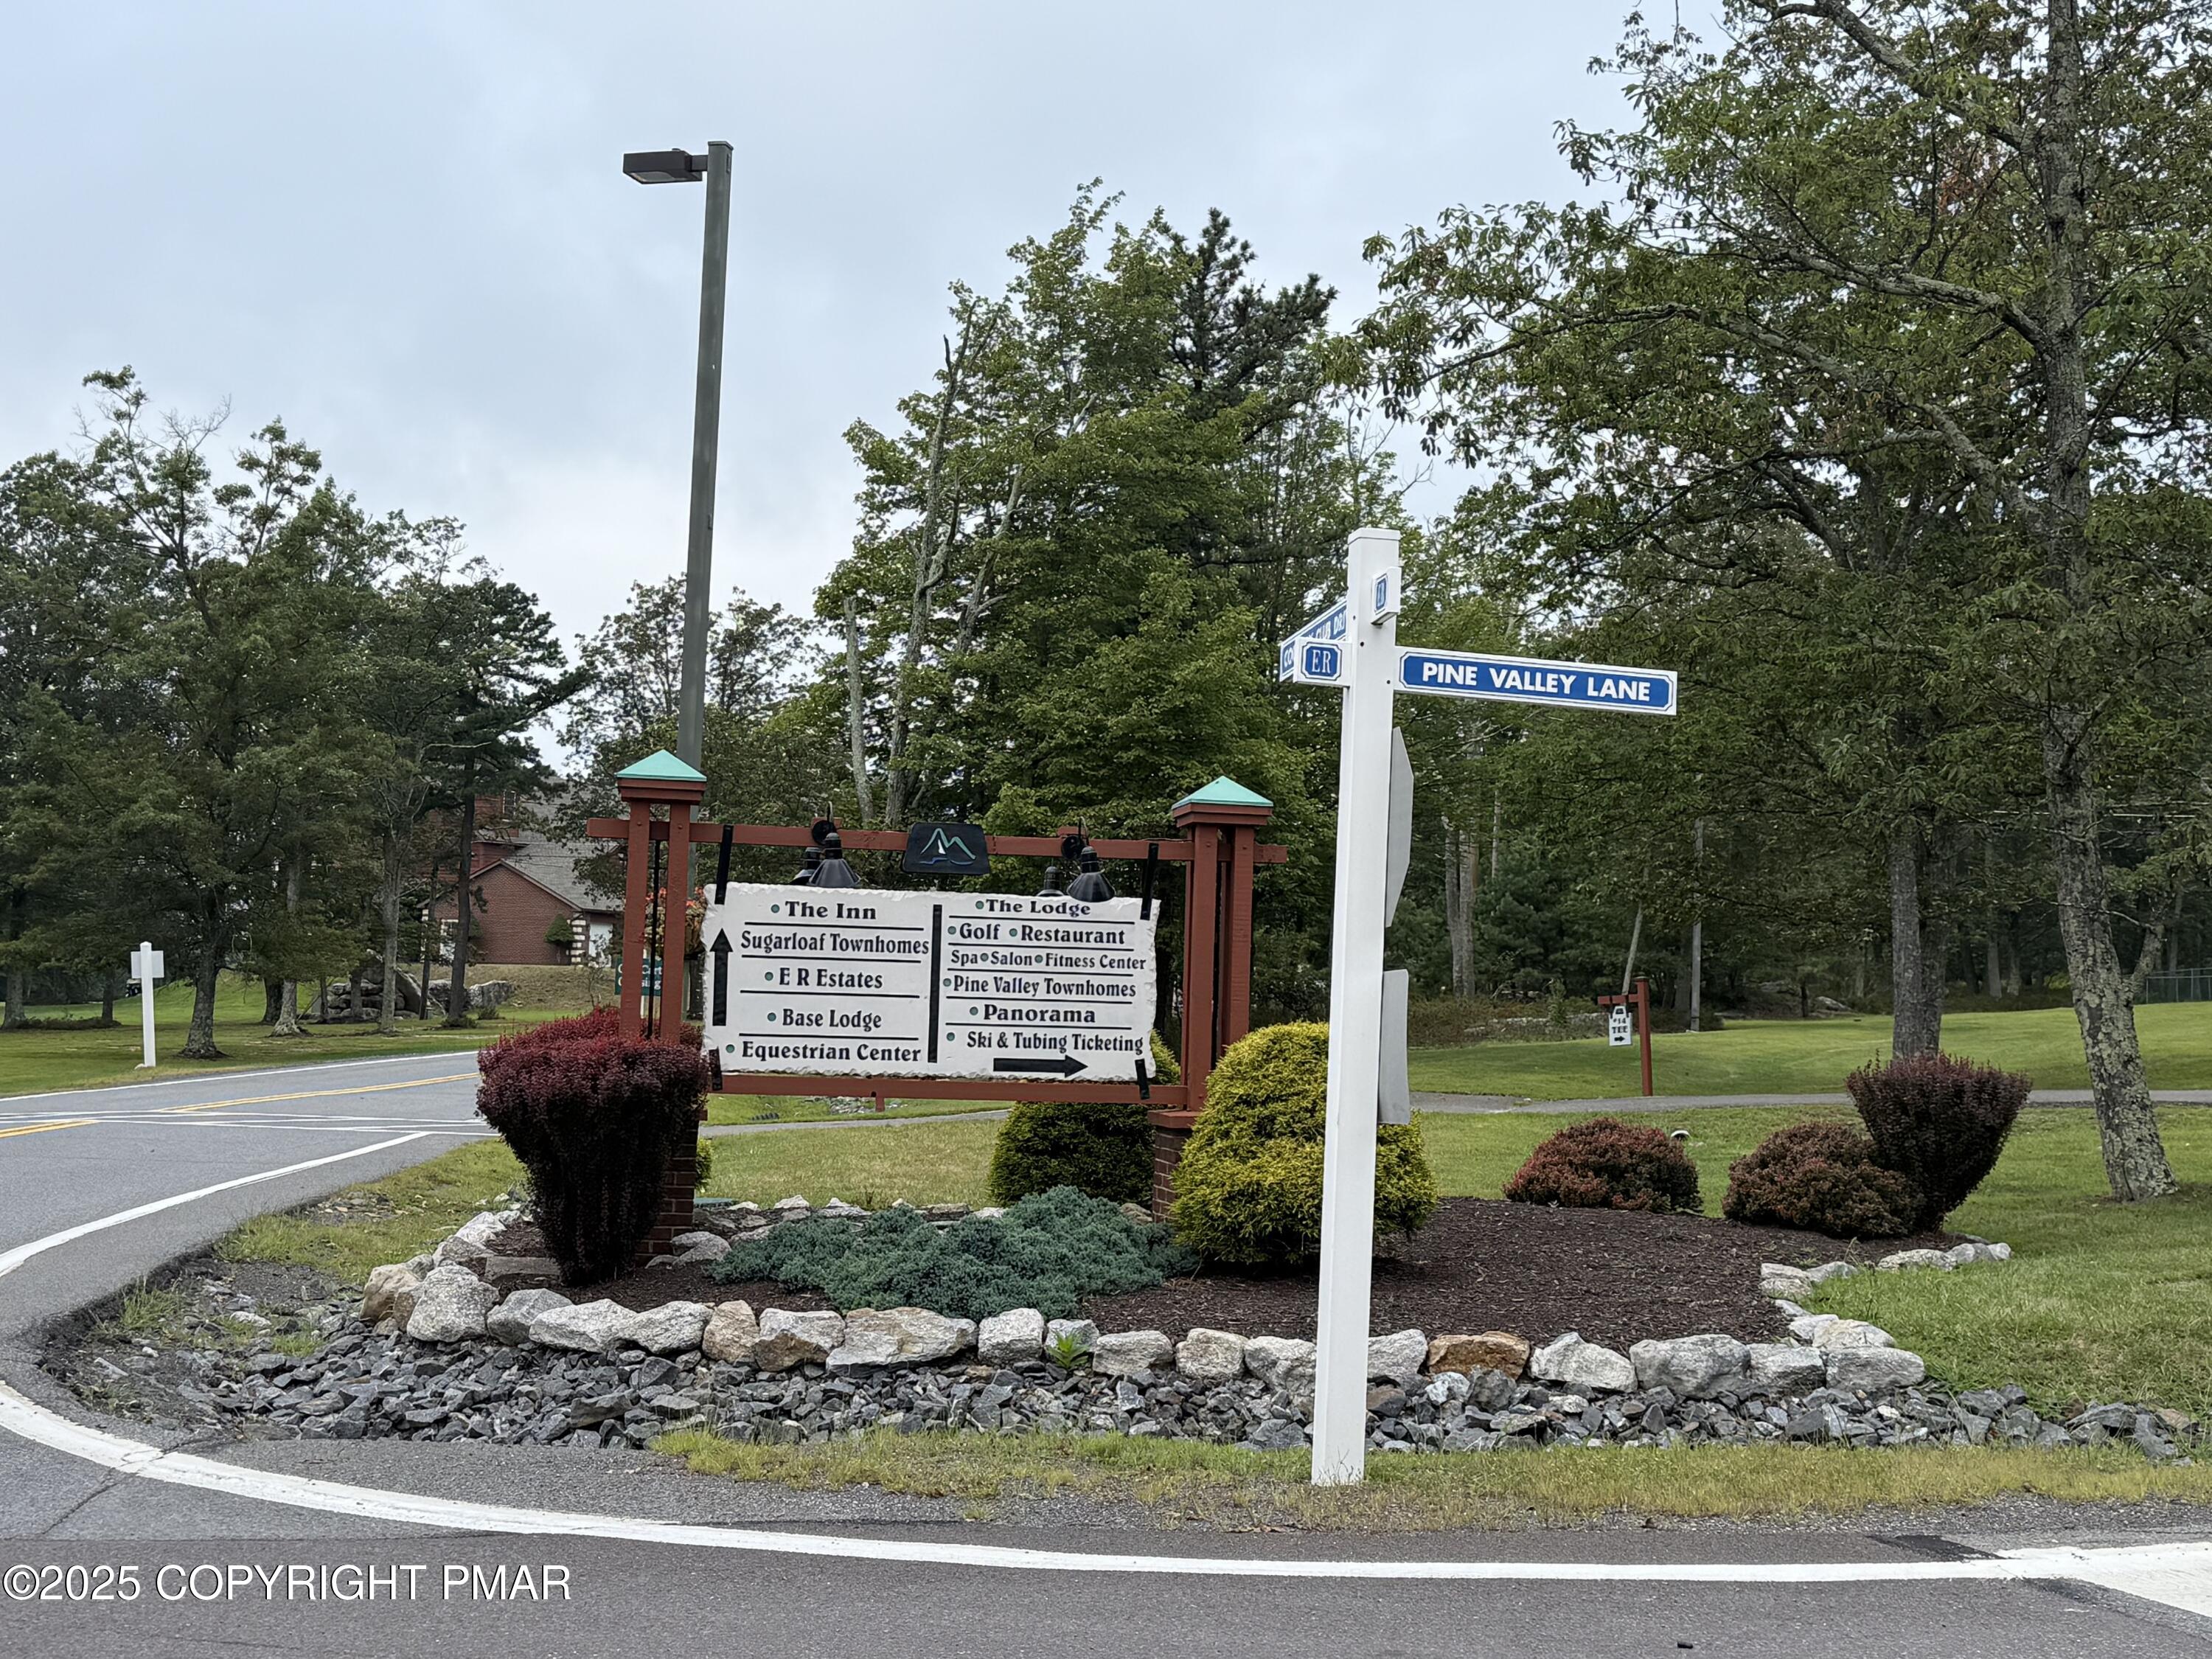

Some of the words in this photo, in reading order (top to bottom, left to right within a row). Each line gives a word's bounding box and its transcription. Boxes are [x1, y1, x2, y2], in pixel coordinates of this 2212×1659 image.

[1312, 650, 1331, 673] ER
[1422, 662, 1478, 686] PINE
[1489, 667, 1576, 694] VALLEY
[1587, 677, 1651, 701] LANE
[785, 901, 827, 917] The
[837, 903, 876, 919] Inn
[986, 899, 1023, 914] The
[1031, 900, 1091, 917] Lodge
[741, 931, 826, 953] Sugarloaf
[830, 933, 929, 954] Townhomes
[960, 923, 1001, 939] Golf
[1021, 925, 1125, 944] Restaurant
[951, 950, 978, 967] Spa
[991, 951, 1032, 966] Salon
[1046, 953, 1095, 967] Fitness
[1099, 955, 1146, 970] Center
[779, 967, 790, 985] E
[797, 968, 809, 986] R
[817, 969, 882, 988] Estates
[954, 975, 988, 992] Pine
[993, 976, 1040, 997] Valley
[1044, 978, 1135, 997] Townhomes
[783, 1009, 823, 1026] Base
[830, 1009, 881, 1032] Lodge
[983, 1004, 1096, 1023] Panorama
[1612, 1026, 1628, 1034] TEE
[742, 1041, 850, 1061] Equestrian
[857, 1044, 921, 1061] Center
[967, 1032, 992, 1048] Ski
[997, 1032, 1009, 1048] &
[1013, 1033, 1067, 1054] Tubing
[1072, 1034, 1143, 1055] Ticketing
